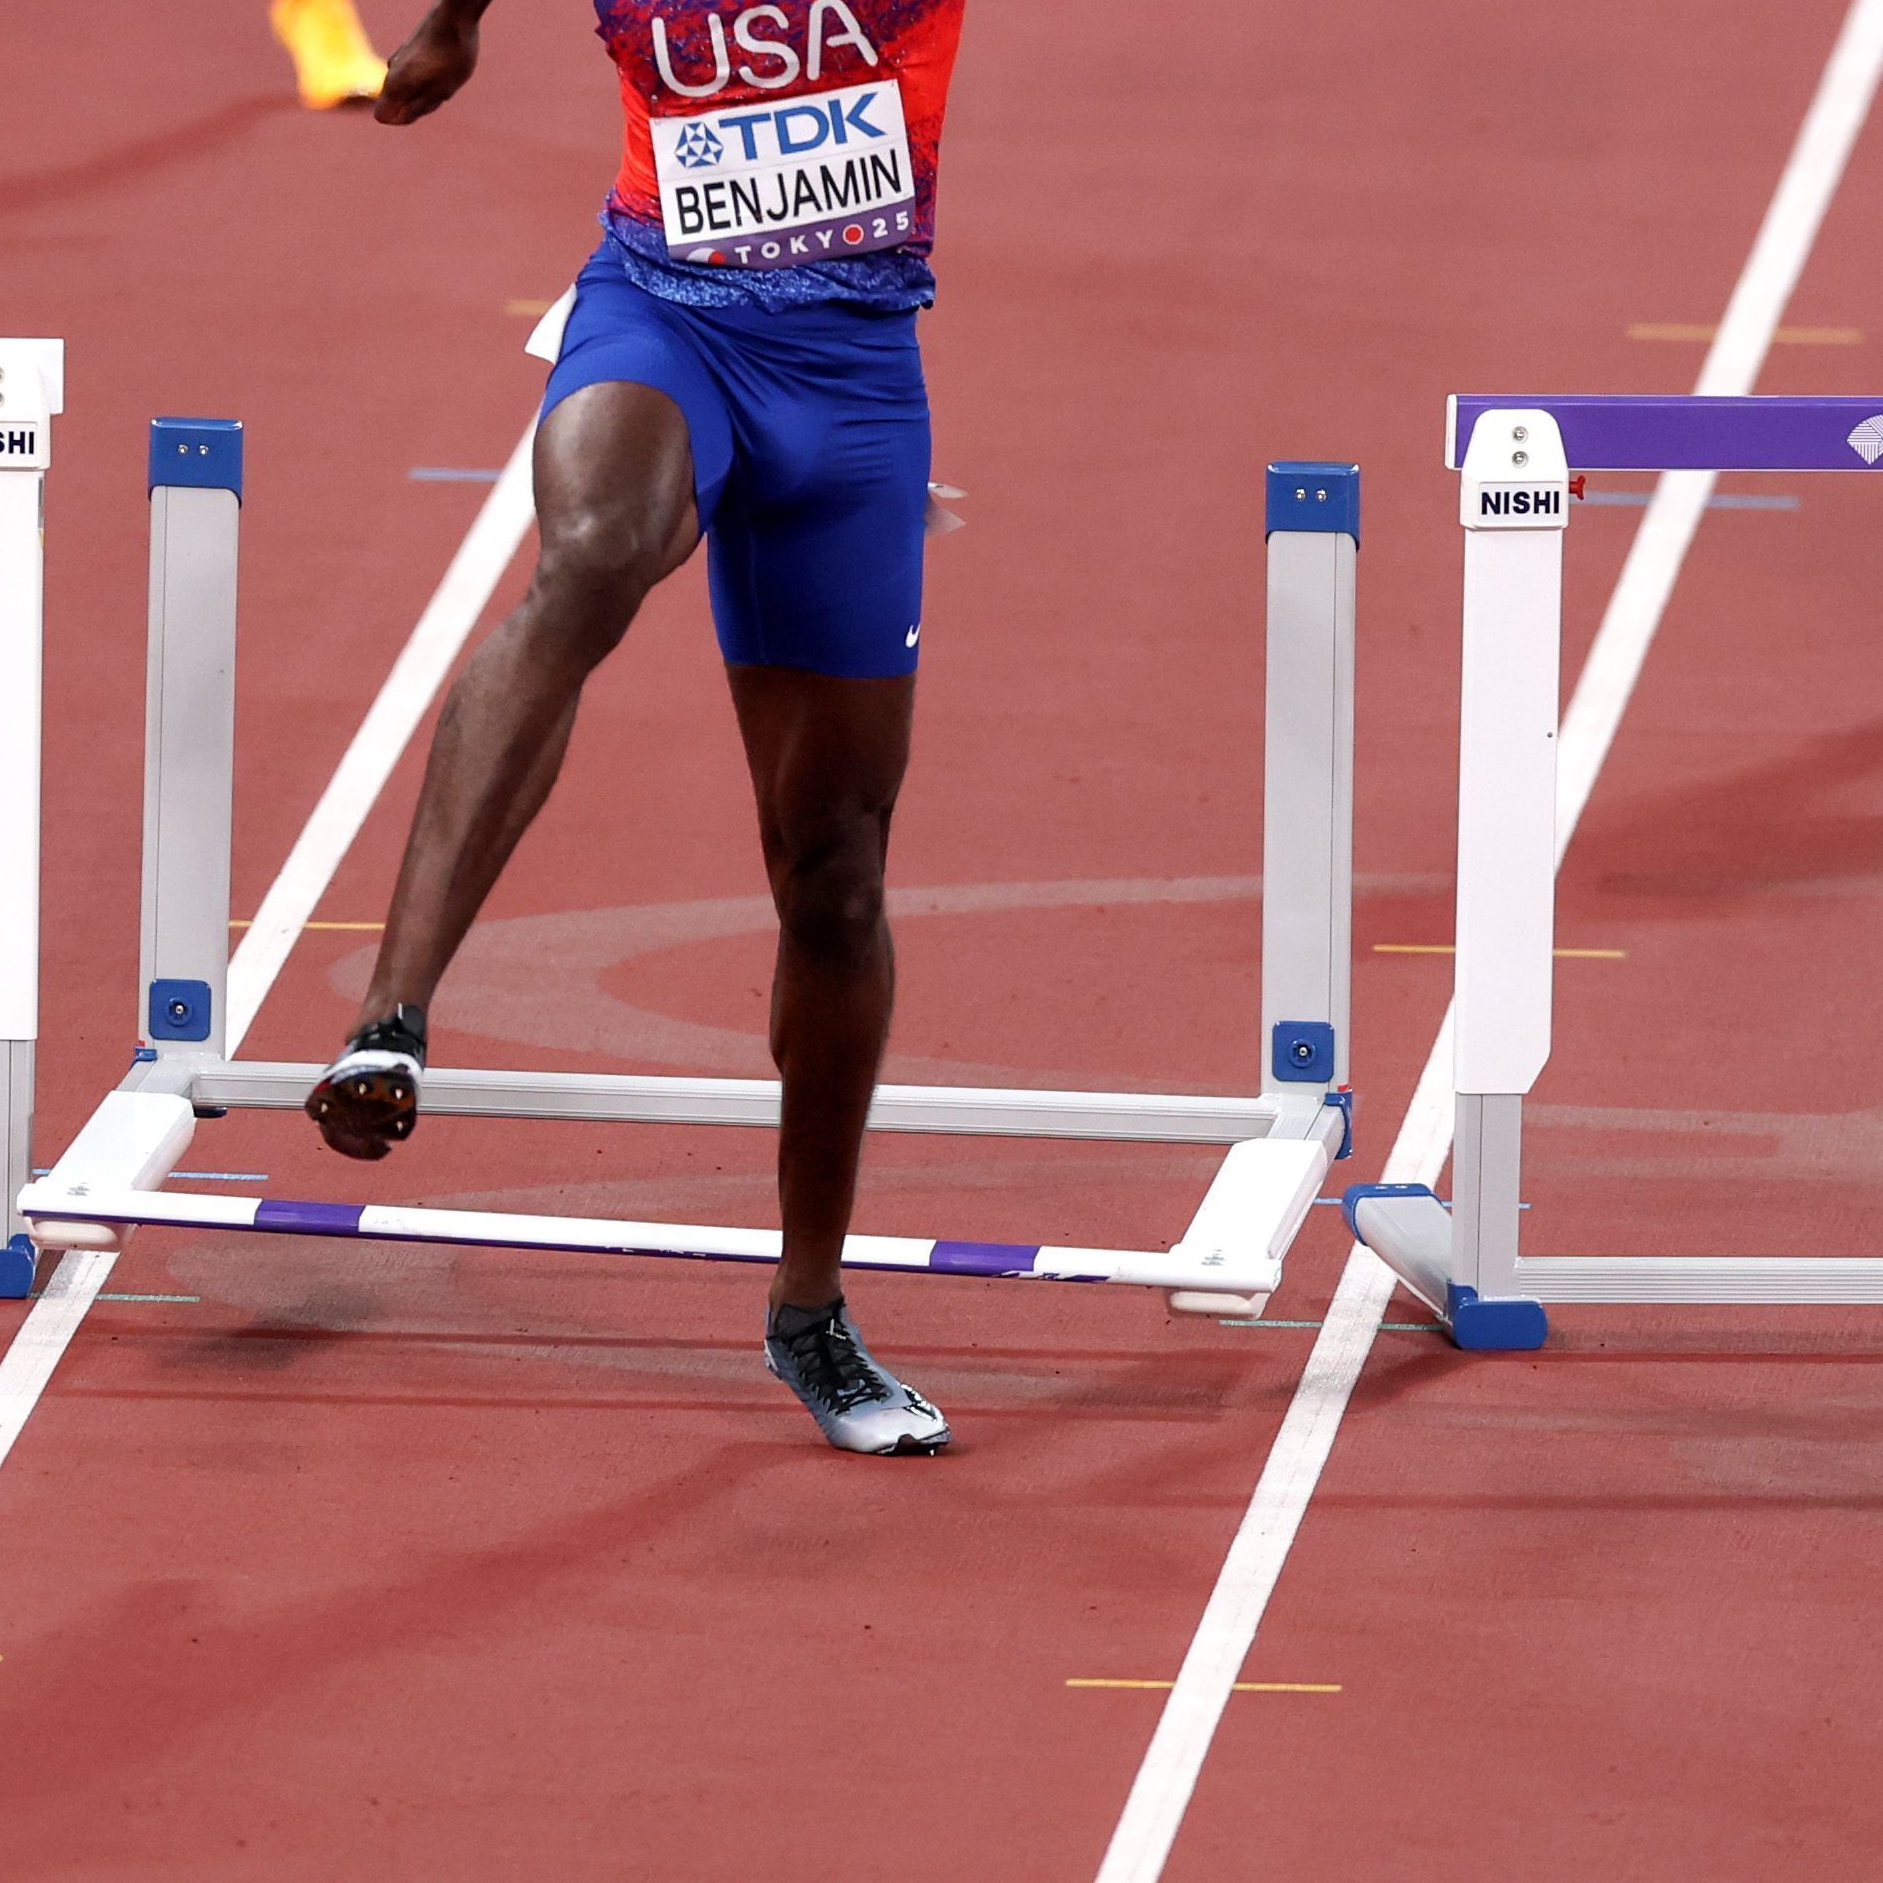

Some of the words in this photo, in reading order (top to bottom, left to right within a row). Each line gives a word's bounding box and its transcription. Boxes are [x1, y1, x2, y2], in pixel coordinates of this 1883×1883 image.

[719, 91, 887, 161] TDK
[674, 149, 903, 236] BENJAMIN
[1480, 489, 1562, 516] NISHI
